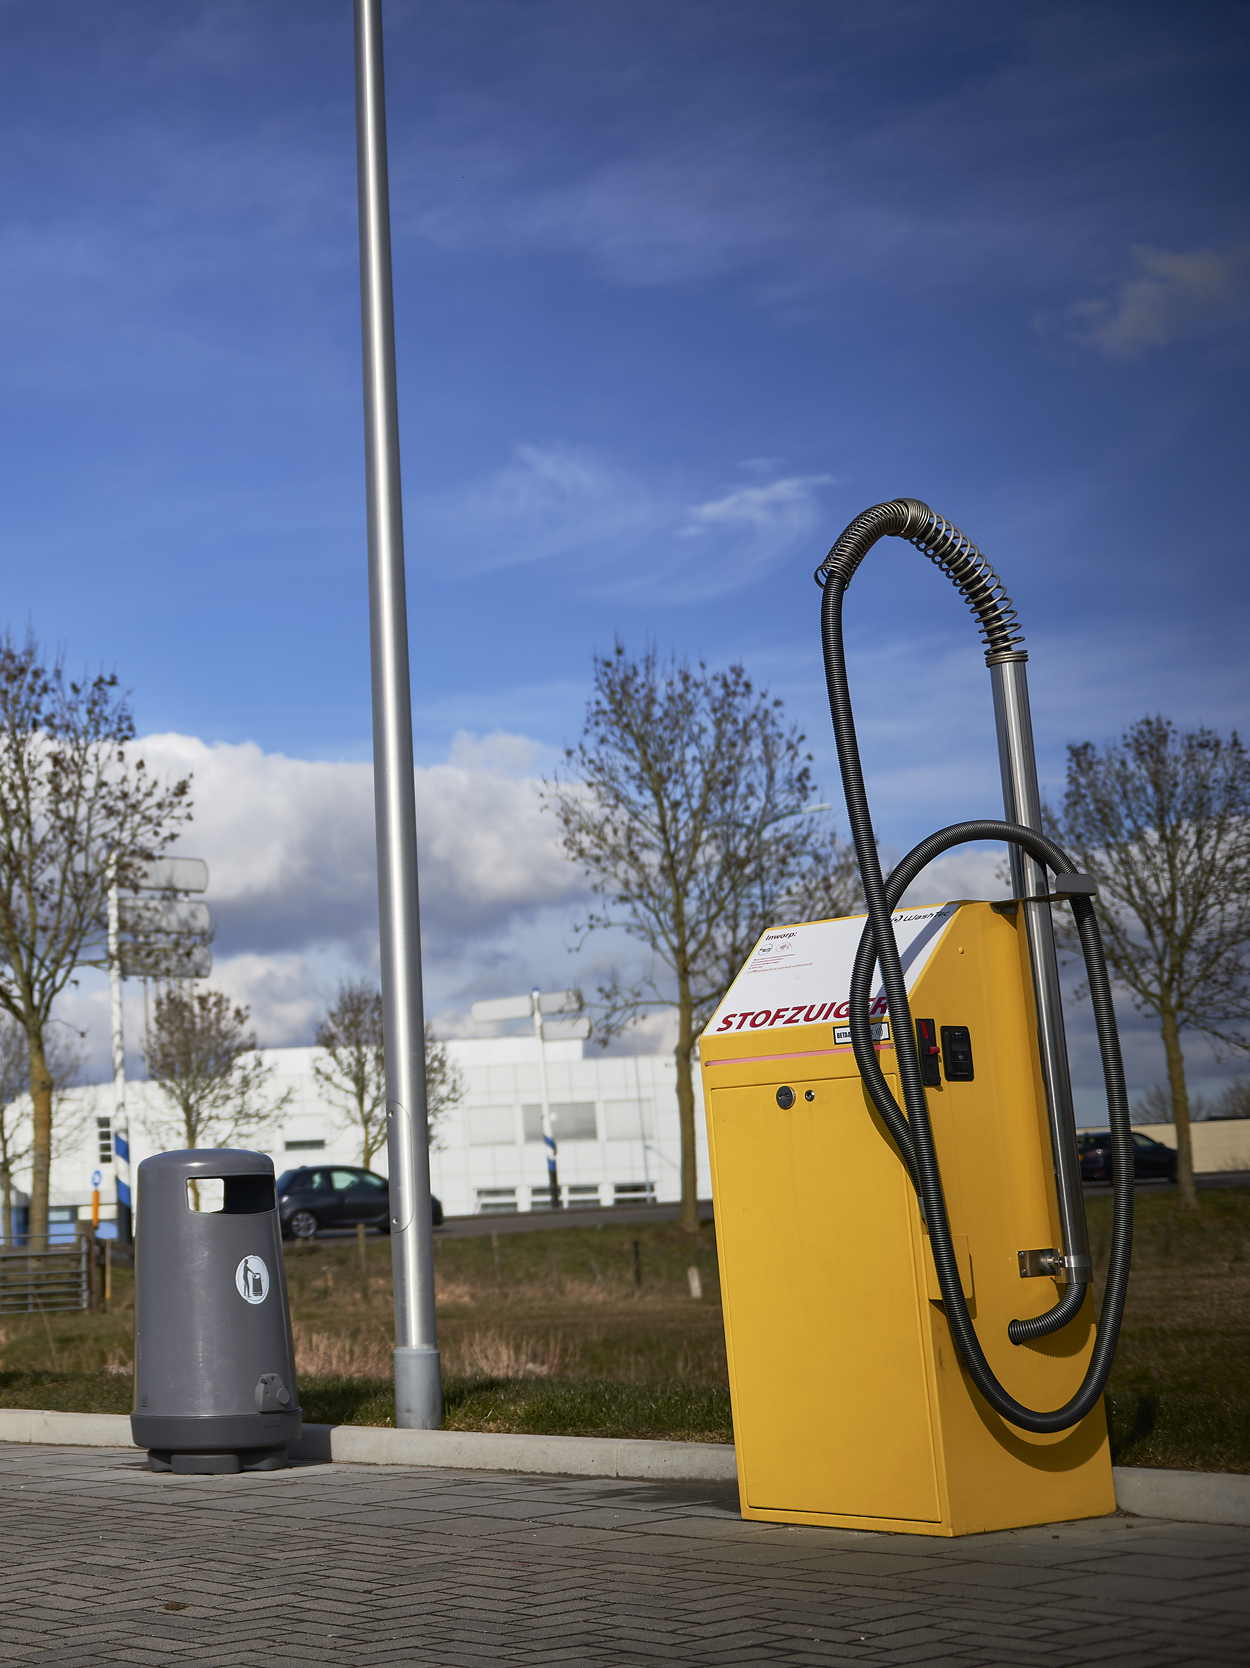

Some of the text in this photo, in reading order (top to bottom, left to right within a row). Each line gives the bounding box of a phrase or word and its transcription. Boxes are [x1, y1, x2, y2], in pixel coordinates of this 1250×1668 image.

[903, 911, 950, 922] WashTec
[765, 932, 798, 941] Inworp:
[716, 996, 888, 1032] STOFZUIGR
